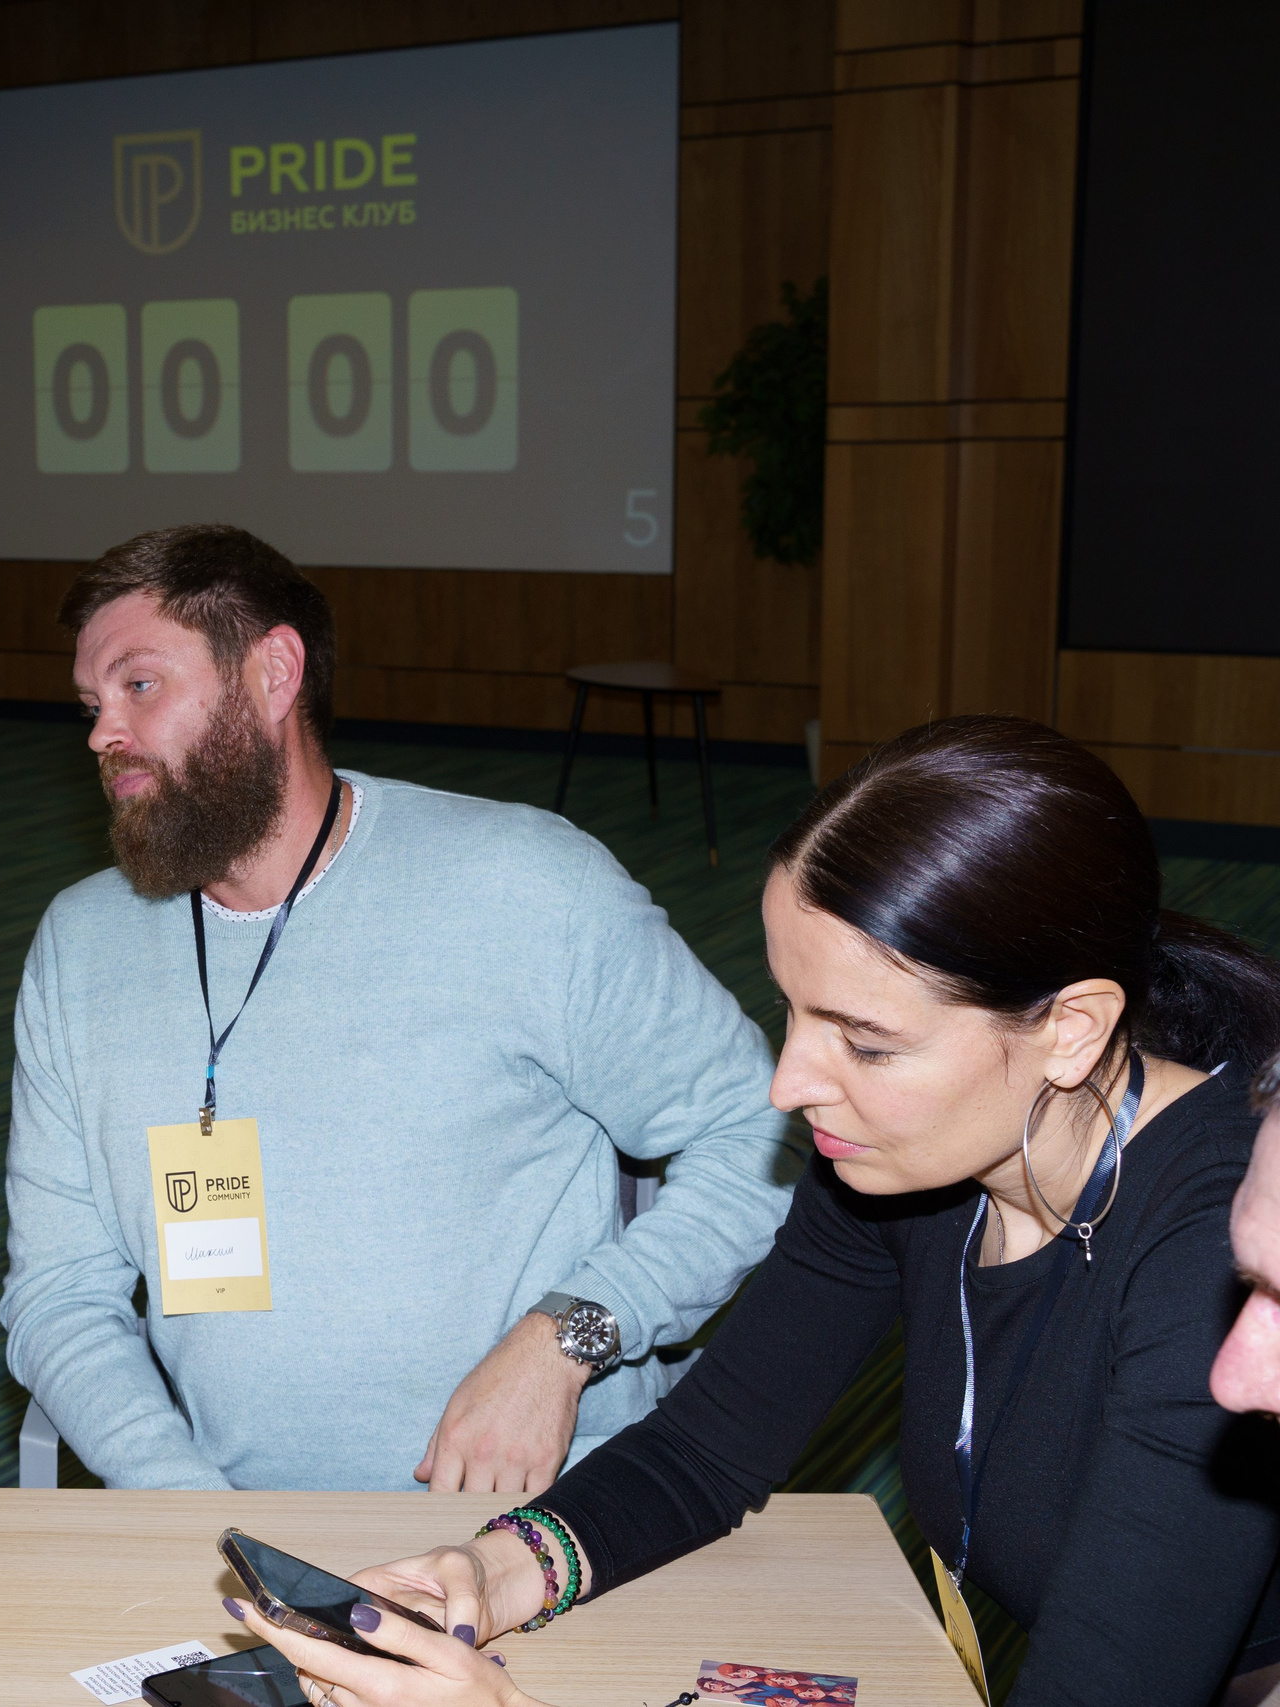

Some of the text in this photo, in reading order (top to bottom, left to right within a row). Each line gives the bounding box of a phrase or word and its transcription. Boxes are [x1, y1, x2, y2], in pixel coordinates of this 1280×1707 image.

[230, 134, 417, 196] PRIDE
[230, 200, 416, 234] БИЗНЕС КЛУБ
[622, 489, 659, 547] 5
[206, 1176, 250, 1192] PRIDE
[208, 1192, 251, 1201] COMMUNITY
